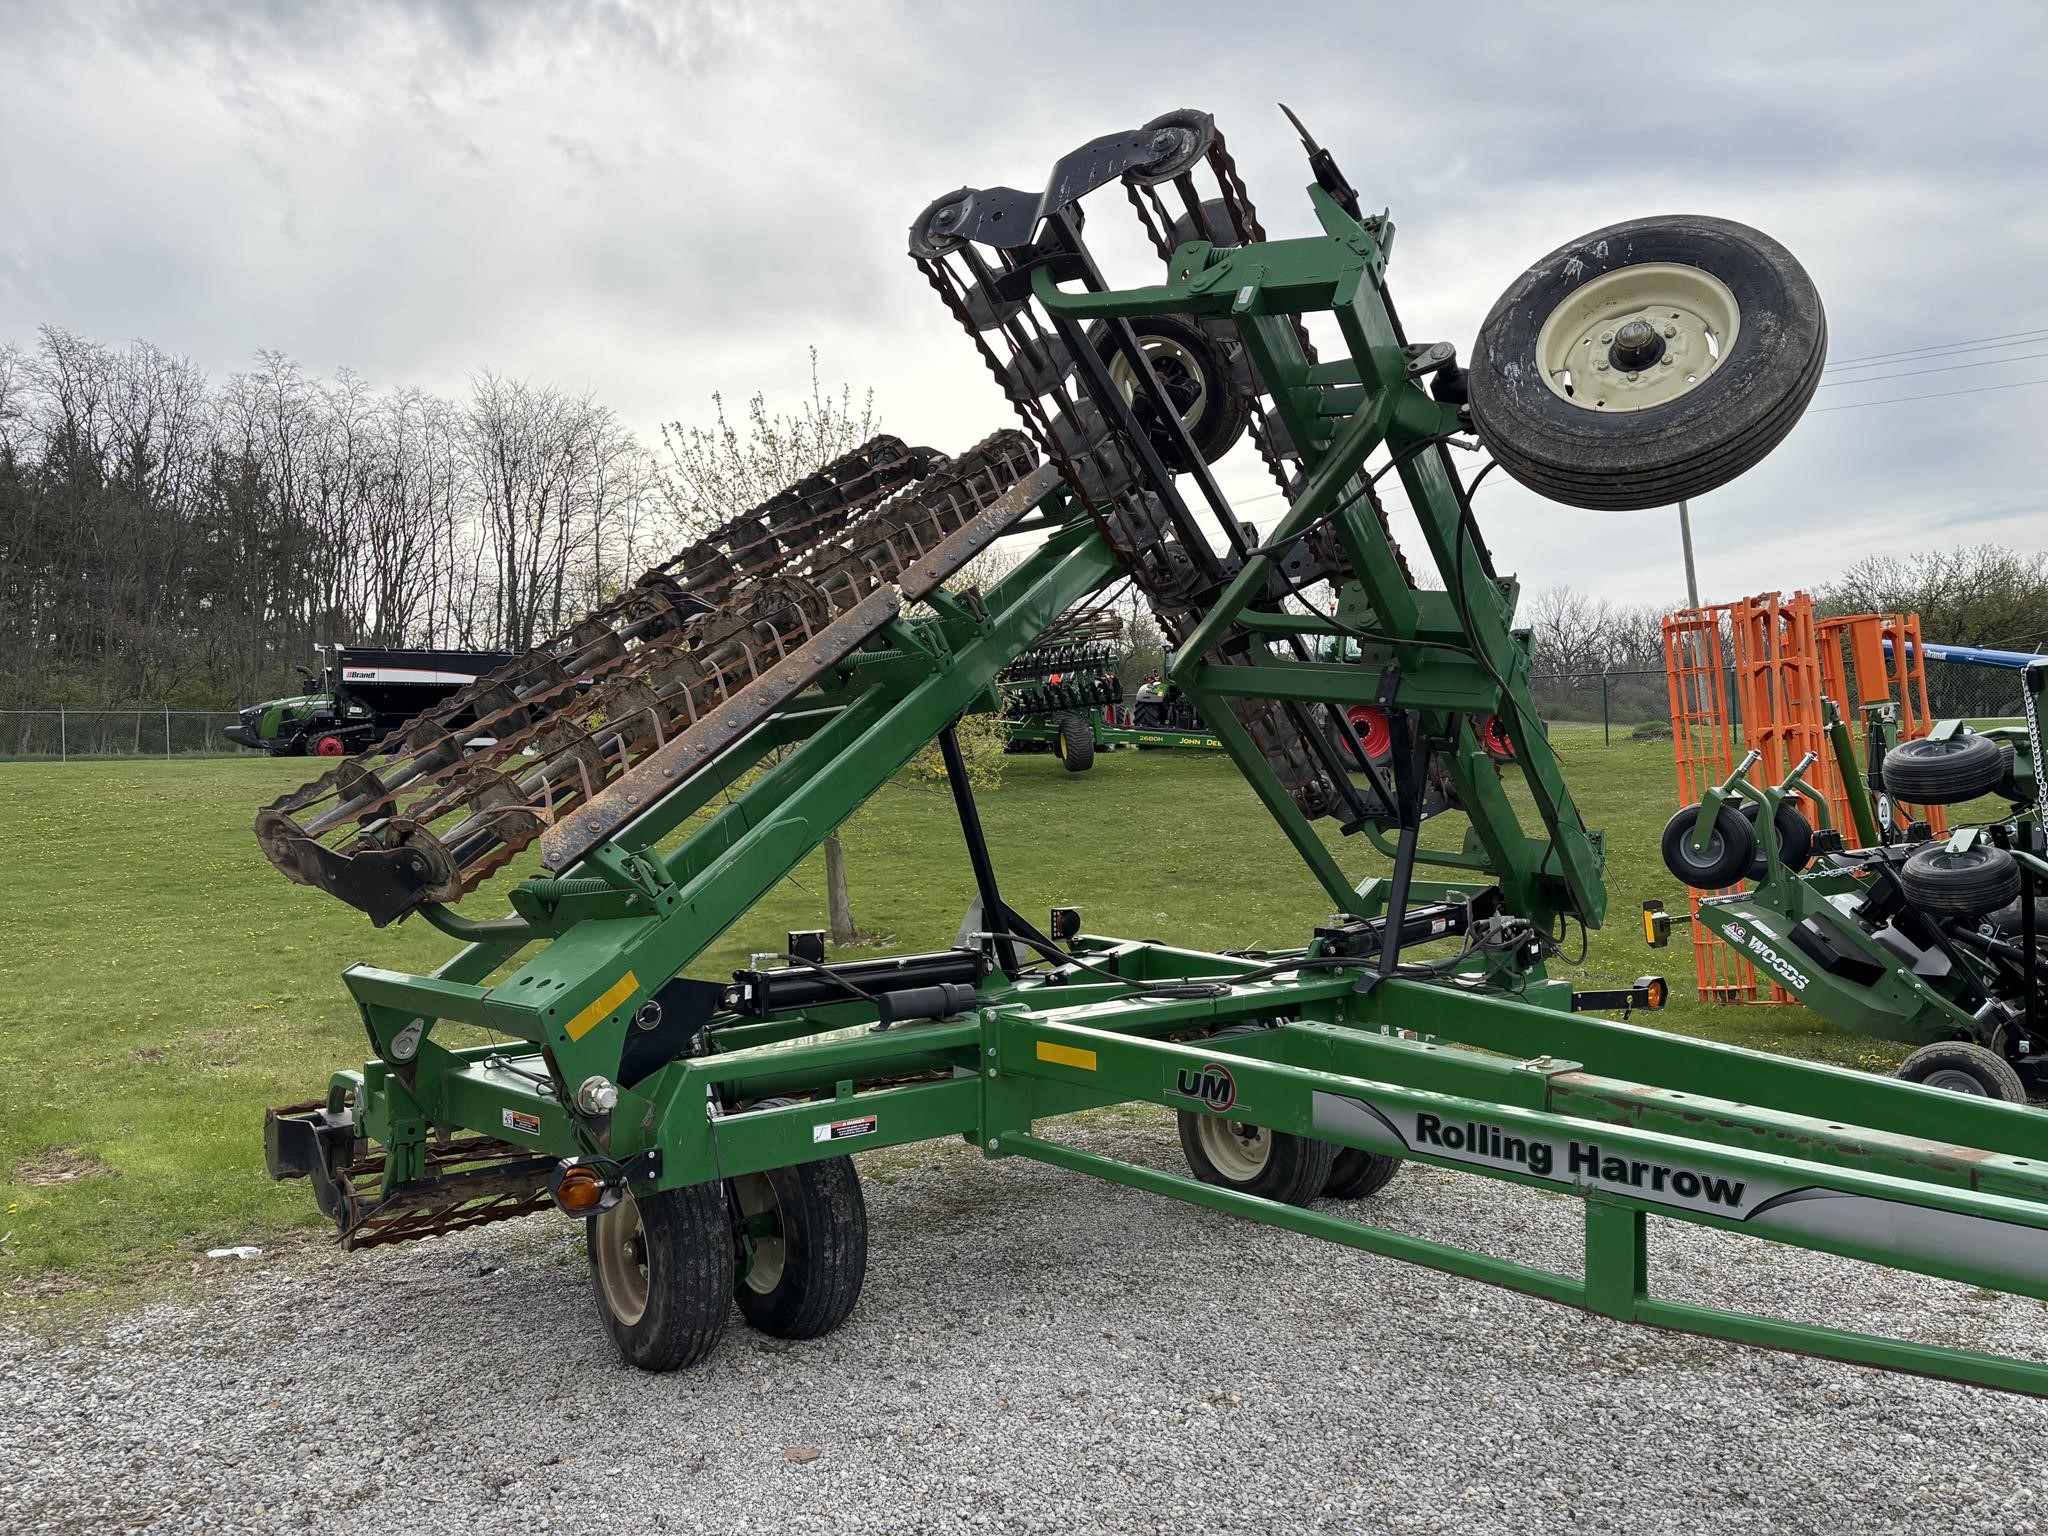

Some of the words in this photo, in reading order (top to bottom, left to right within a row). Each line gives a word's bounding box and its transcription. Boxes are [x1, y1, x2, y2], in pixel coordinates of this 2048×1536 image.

[1179, 737, 1201, 745] JOHN
[1730, 923, 1746, 938] AG
[1748, 936, 1810, 990] WOODS
[1177, 1068, 1231, 1103] UM
[1416, 1112, 1553, 1176] Rolling
[1568, 1141, 1747, 1207] Harrow
